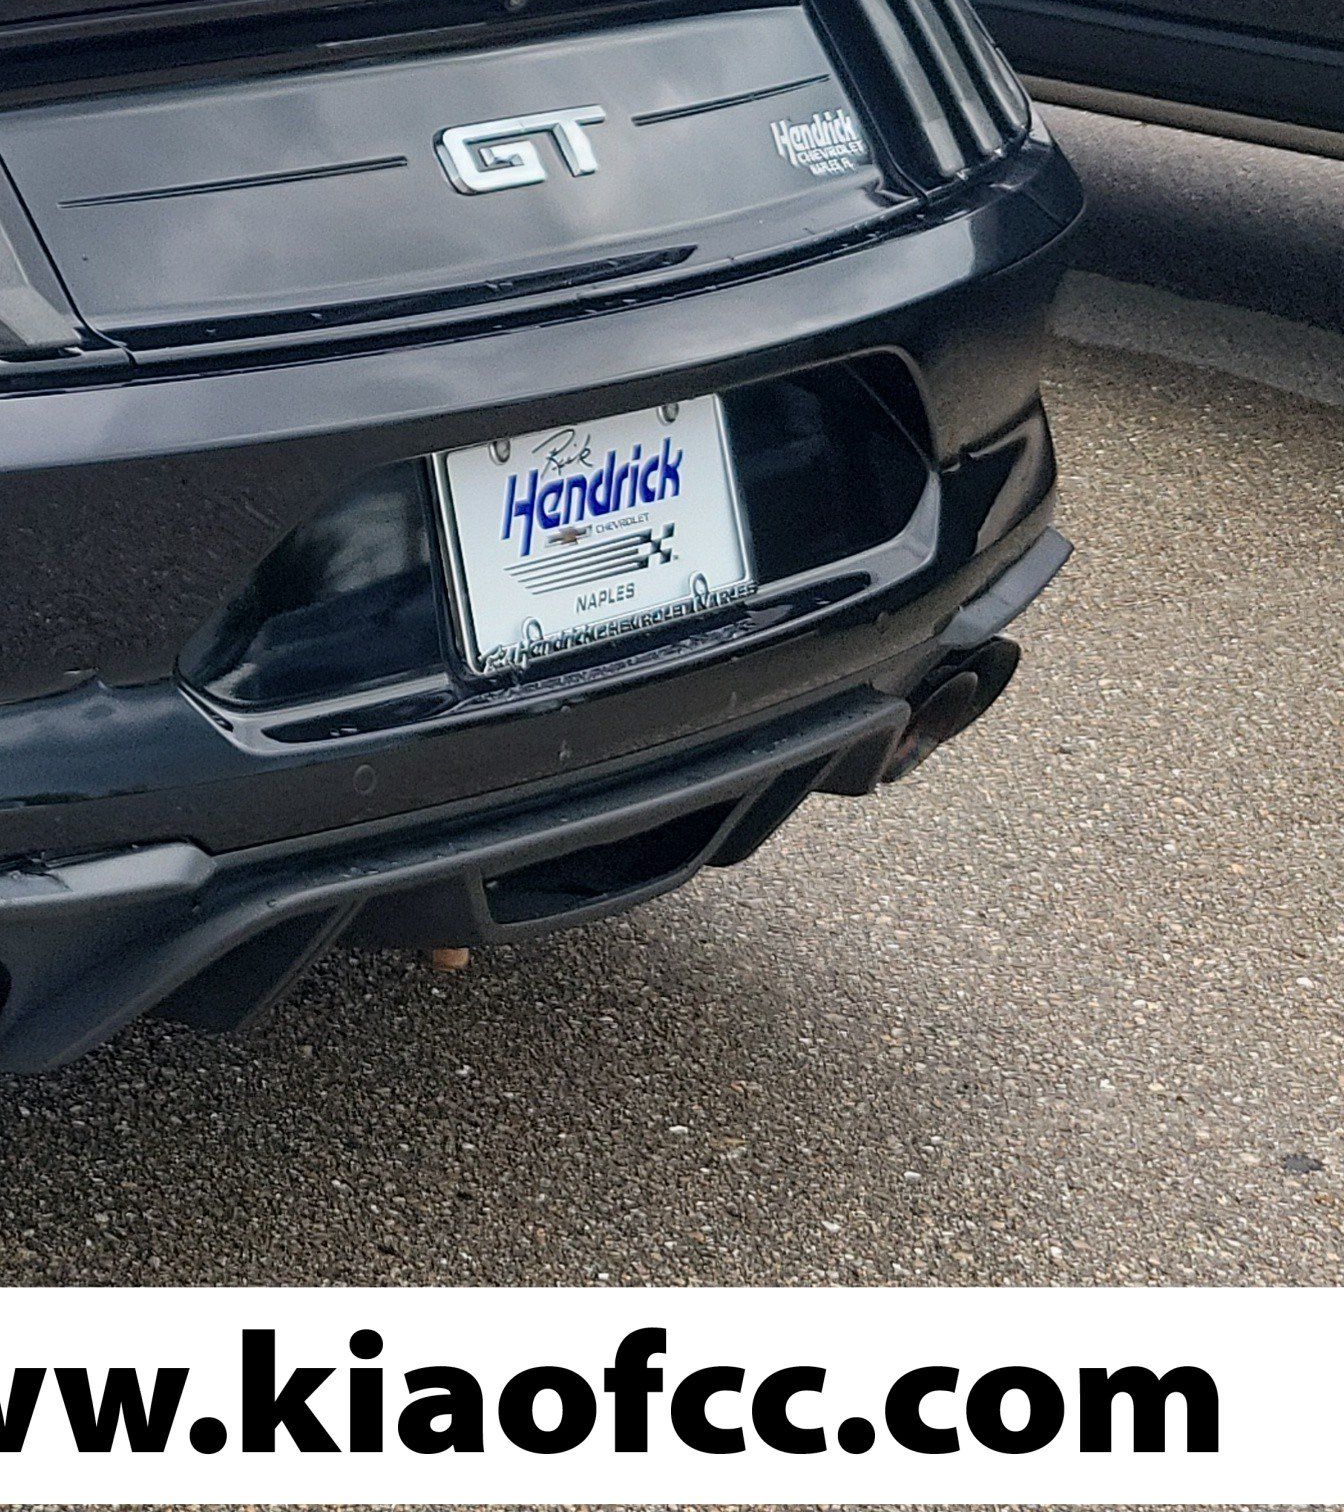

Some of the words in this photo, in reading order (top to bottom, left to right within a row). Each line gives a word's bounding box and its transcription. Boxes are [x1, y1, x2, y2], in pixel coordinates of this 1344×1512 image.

[432, 105, 606, 196] GT
[770, 108, 857, 168] Hendrick
[502, 437, 683, 556] Hendrick
[596, 512, 650, 534] CHEVROLET
[575, 582, 635, 614] NAPLES
[595, 602, 688, 638] CHEVROLET
[692, 581, 759, 614] NAPLES
